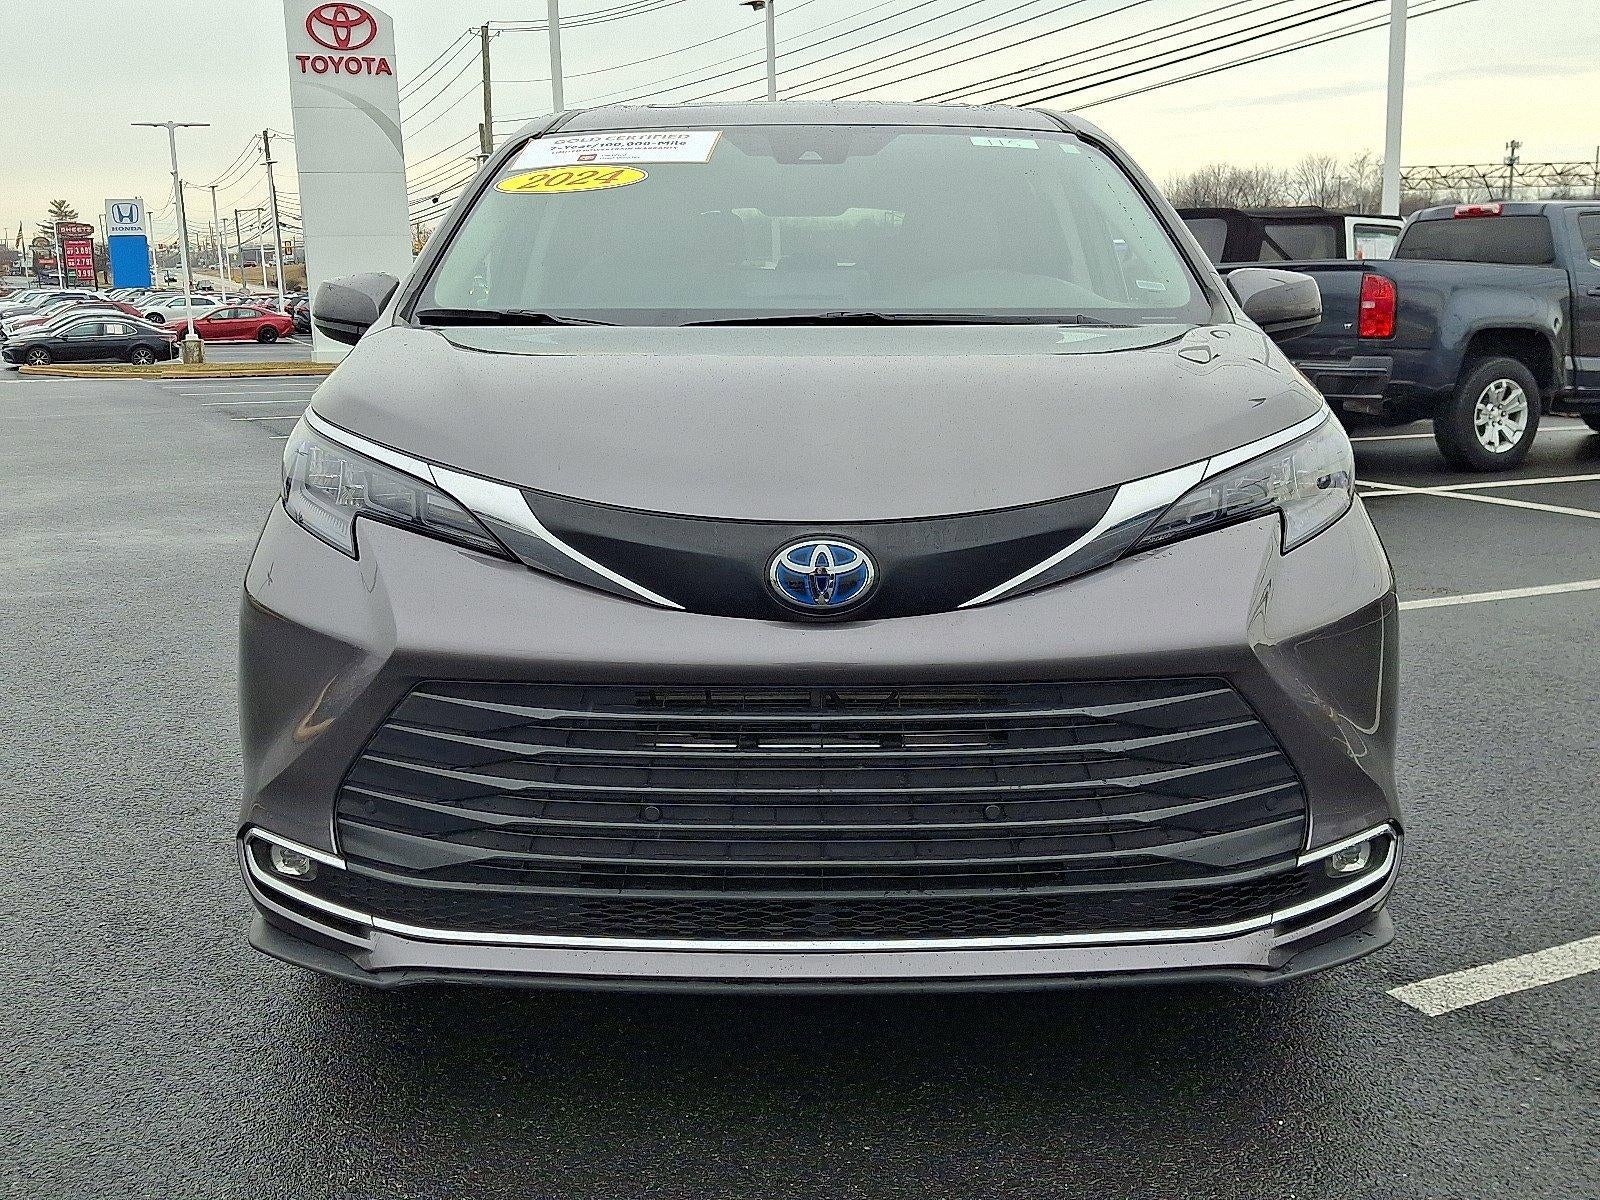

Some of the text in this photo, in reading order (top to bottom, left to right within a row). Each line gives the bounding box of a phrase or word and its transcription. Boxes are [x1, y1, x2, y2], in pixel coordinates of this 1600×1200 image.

[295, 55, 393, 76] TOYOTA
[554, 137, 602, 145] GOLD
[516, 169, 626, 190] 2024
